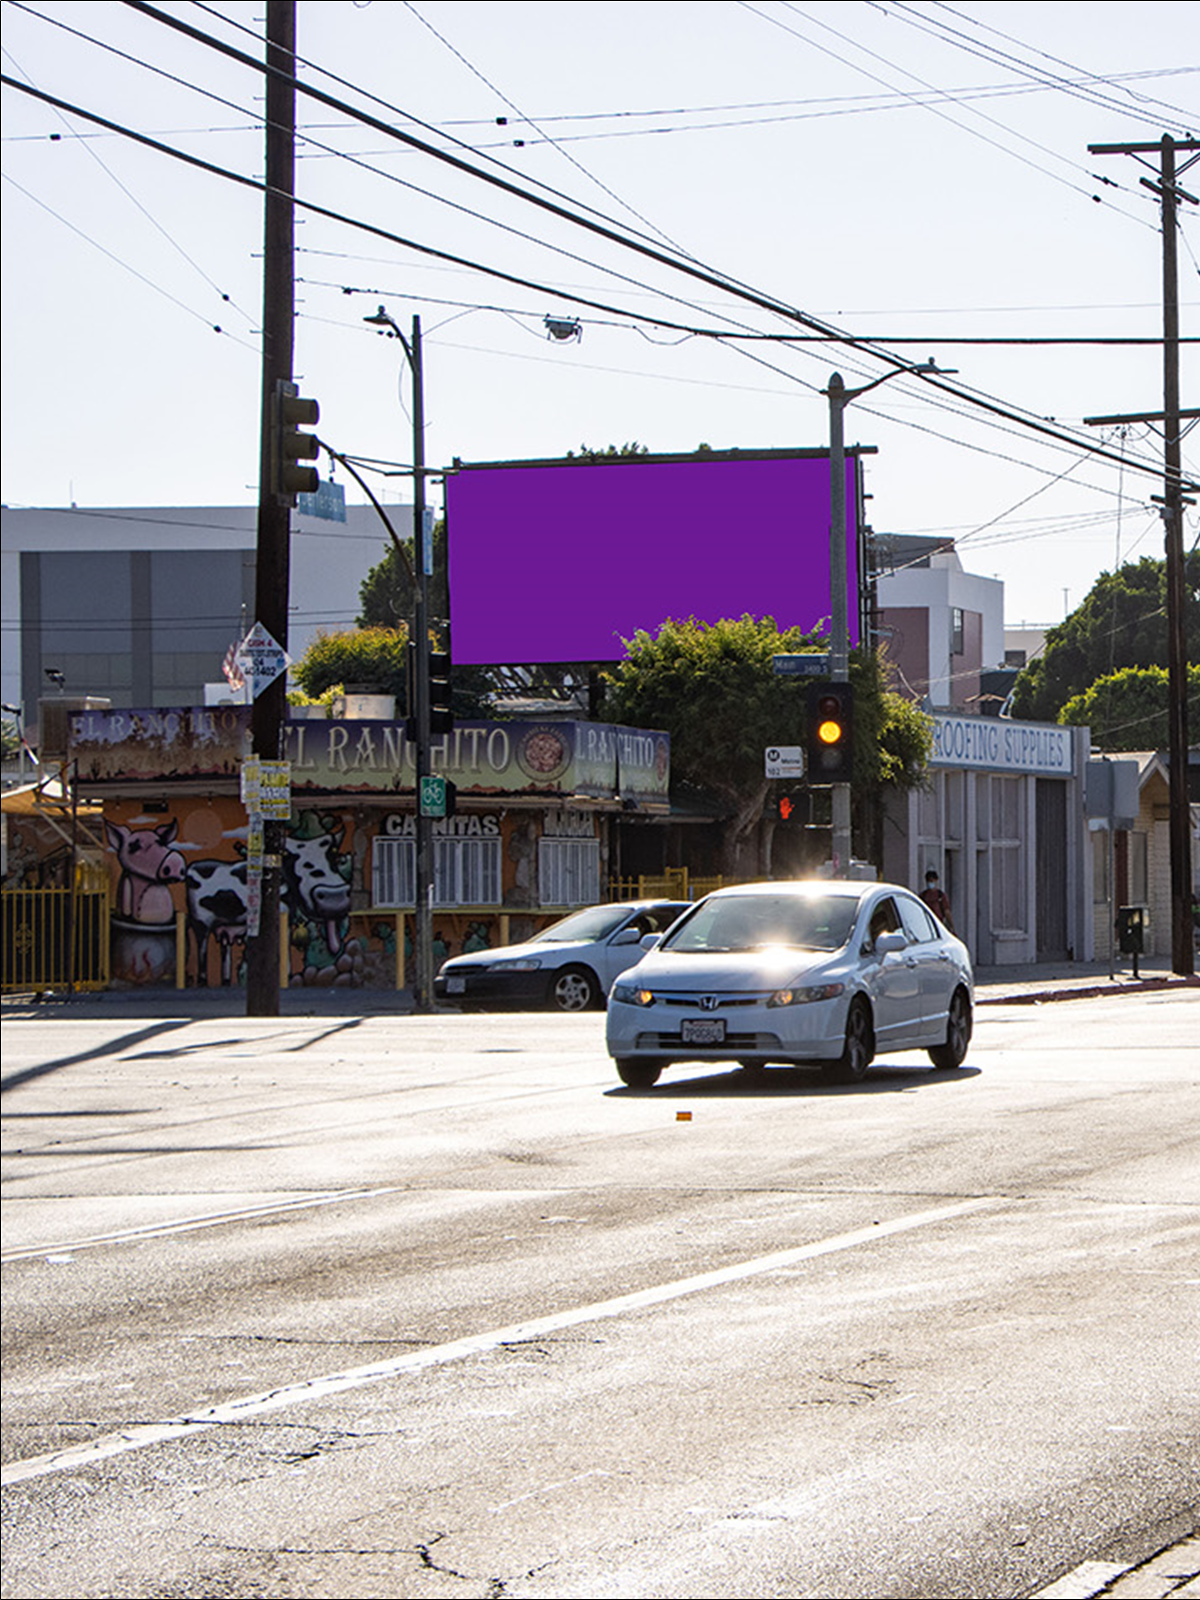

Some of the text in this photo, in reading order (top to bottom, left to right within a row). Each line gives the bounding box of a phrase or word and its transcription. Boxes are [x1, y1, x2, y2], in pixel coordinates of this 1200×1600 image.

[774, 659, 797, 670] Main
[71, 711, 238, 738] EL RANCHITO
[933, 720, 1064, 767] ROOFING SUPPLIES
[385, 814, 500, 836] CANITAS
